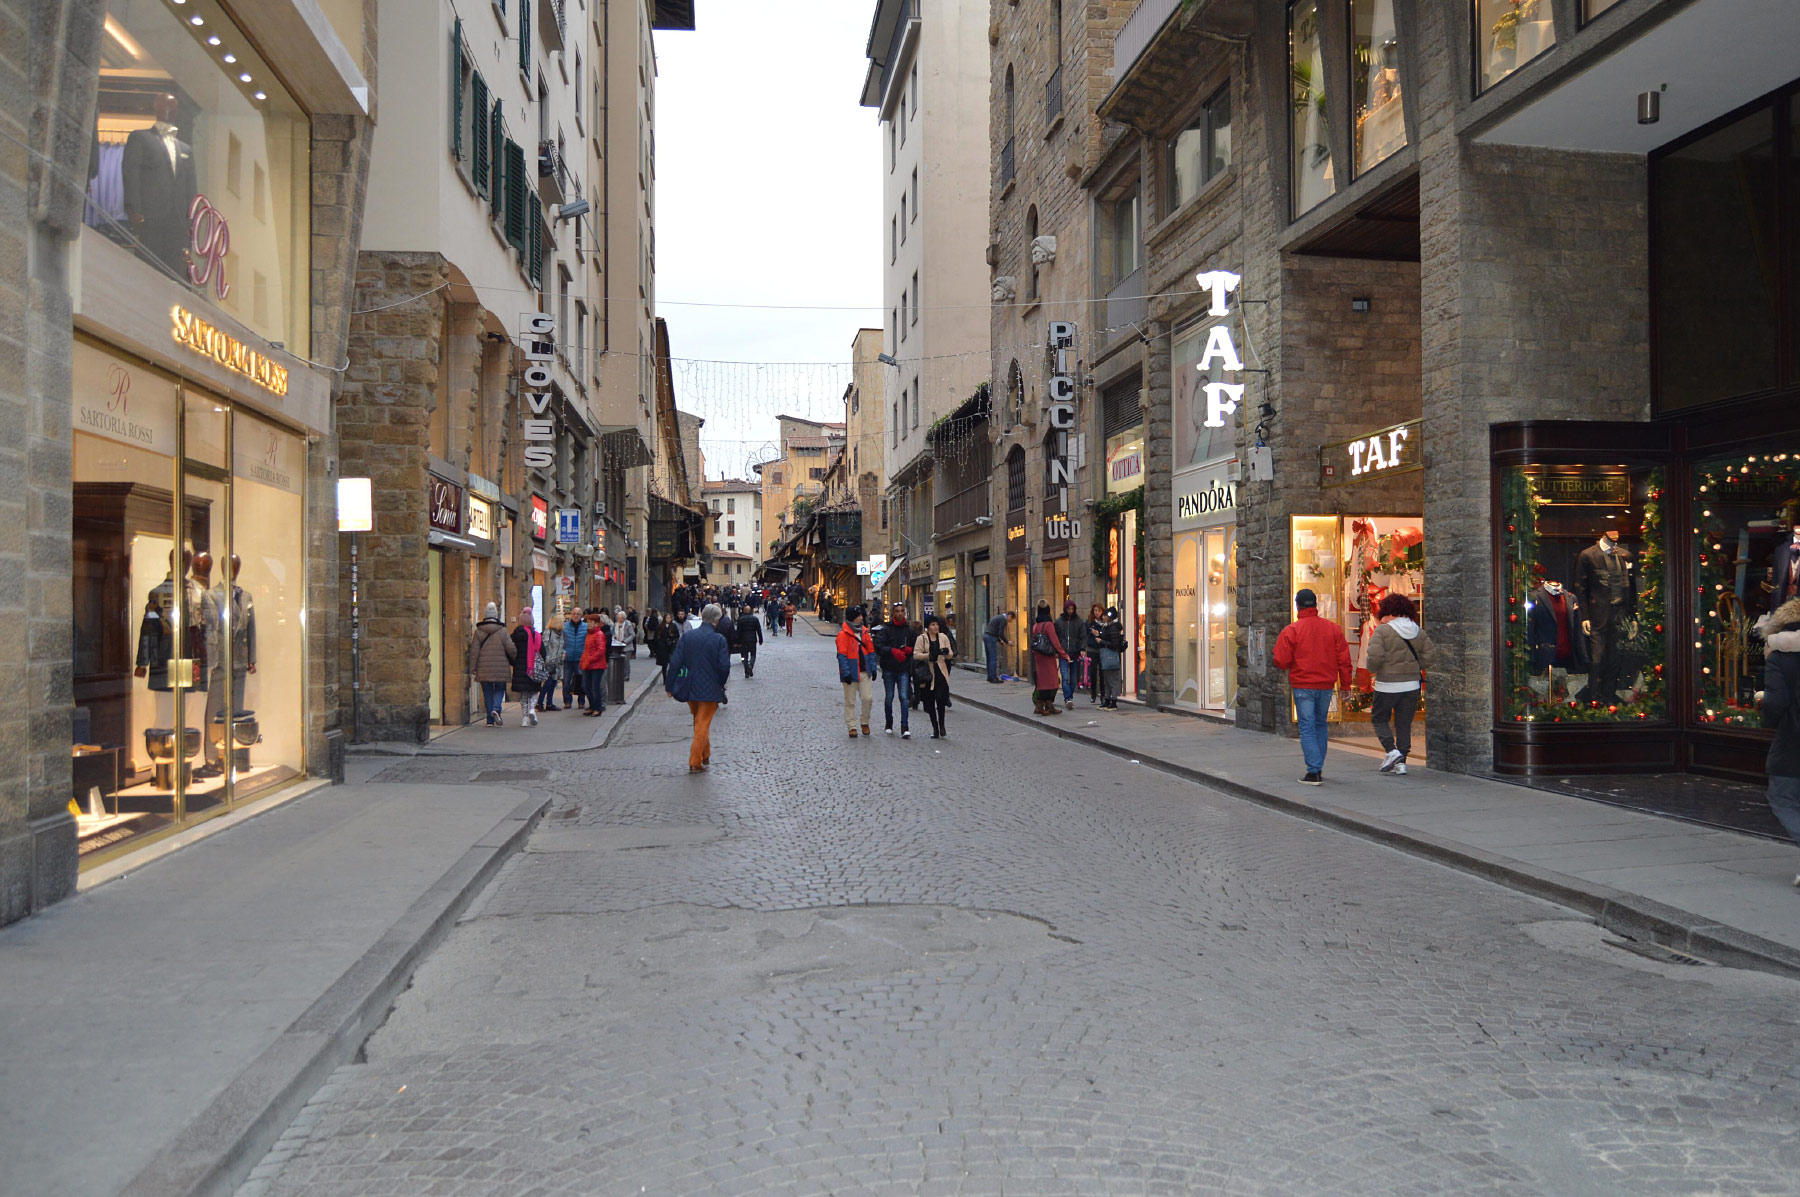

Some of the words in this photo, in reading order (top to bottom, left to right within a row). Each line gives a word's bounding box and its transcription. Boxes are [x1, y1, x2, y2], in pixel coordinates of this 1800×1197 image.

[172, 305, 249, 377] SARTORIA
[1196, 270, 1244, 427] TAF
[524, 312, 554, 468] GLOVES
[80, 406, 127, 437] SARTORIA
[128, 422, 153, 444] ROSSI
[1050, 321, 1074, 512] PICCINI
[1112, 454, 1141, 480] OTTICA
[1349, 428, 1408, 476] TAF
[250, 464, 277, 484] SARTORIA
[277, 472, 290, 488] ROSSI
[1532, 480, 1614, 492] GUTTERIDGE
[1179, 485, 1234, 518] PANDORA
[1048, 520, 1080, 539] UGO
